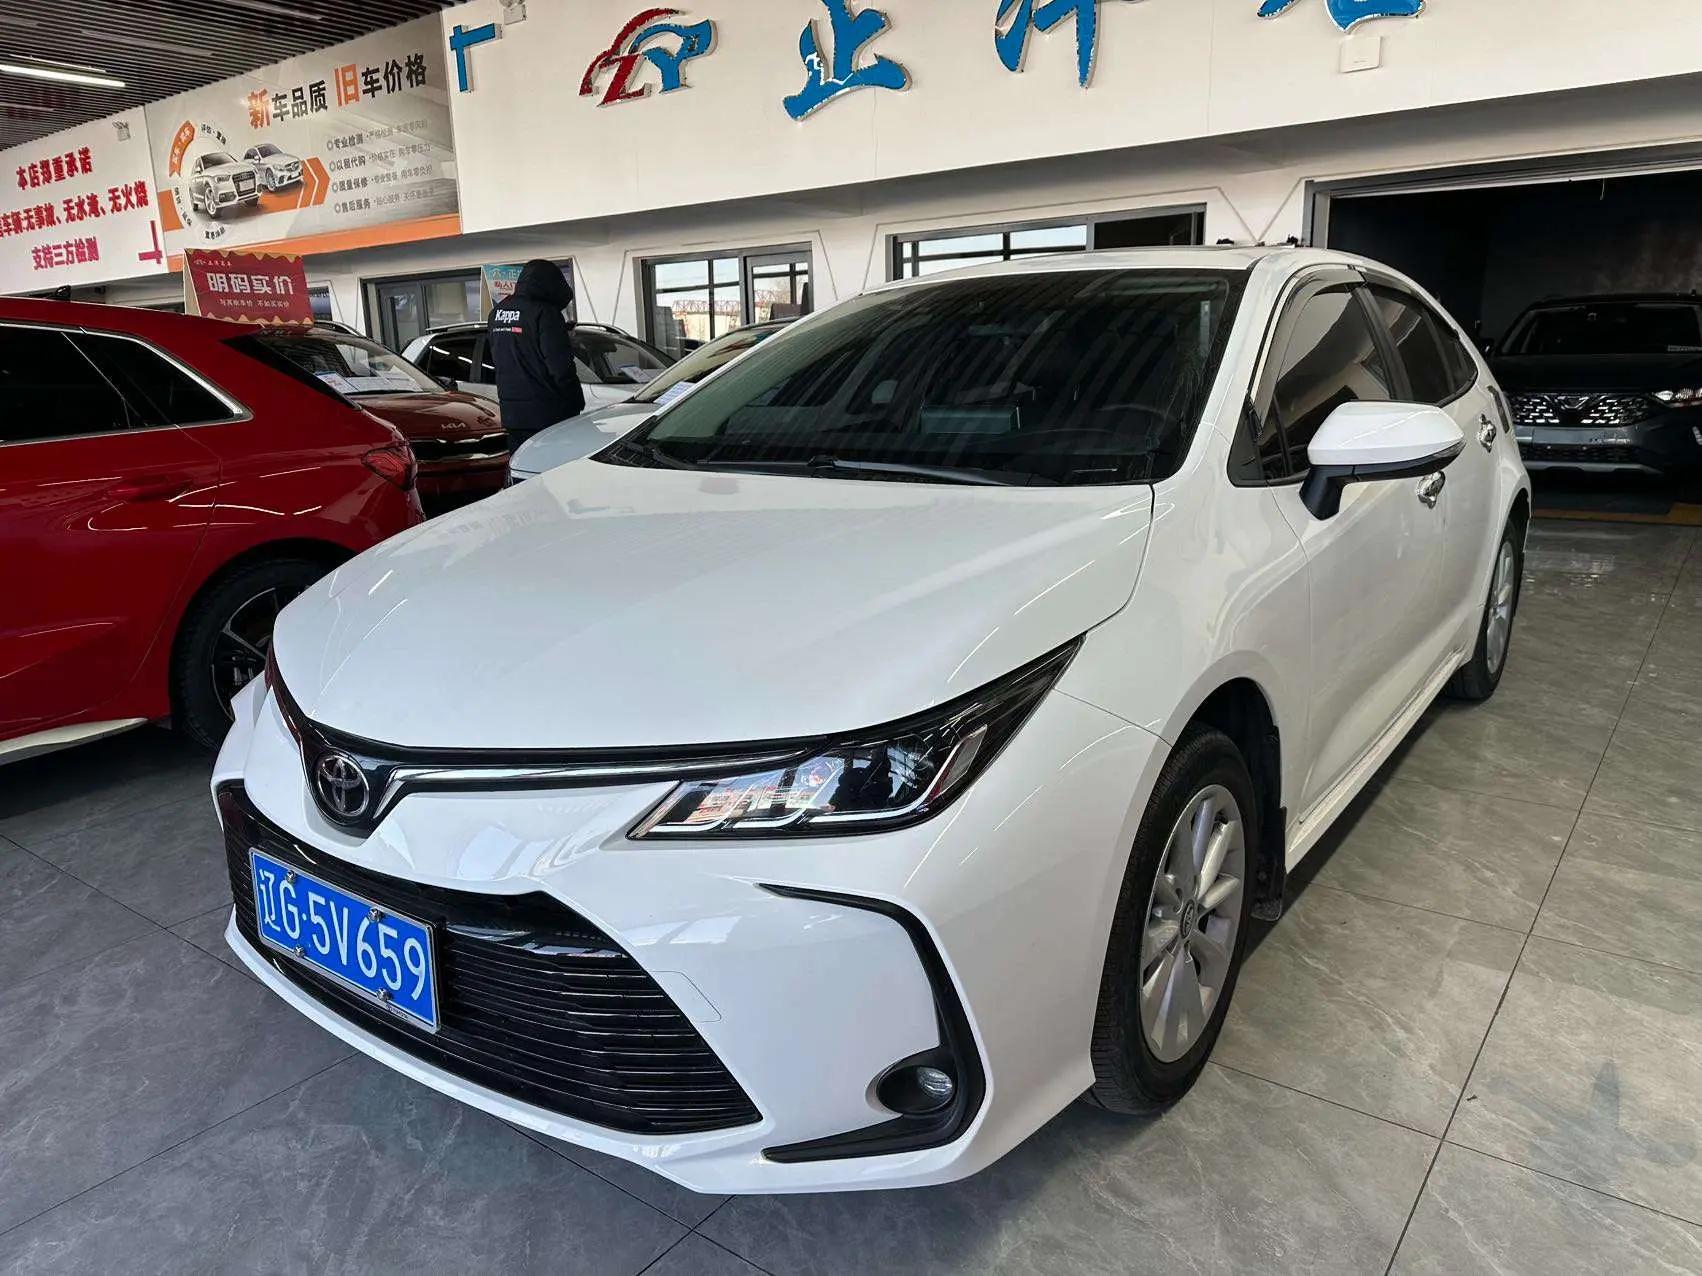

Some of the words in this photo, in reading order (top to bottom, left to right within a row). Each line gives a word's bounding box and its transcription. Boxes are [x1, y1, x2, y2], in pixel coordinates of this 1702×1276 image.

[248, 79, 328, 129] 新车品质
[334, 52, 427, 107] 旧车价格
[16, 146, 92, 190] 本店郑重承诺
[32, 236, 100, 270] 支持三方检测
[206, 272, 294, 295] 明码实价
[495, 309, 520, 323] Kappa
